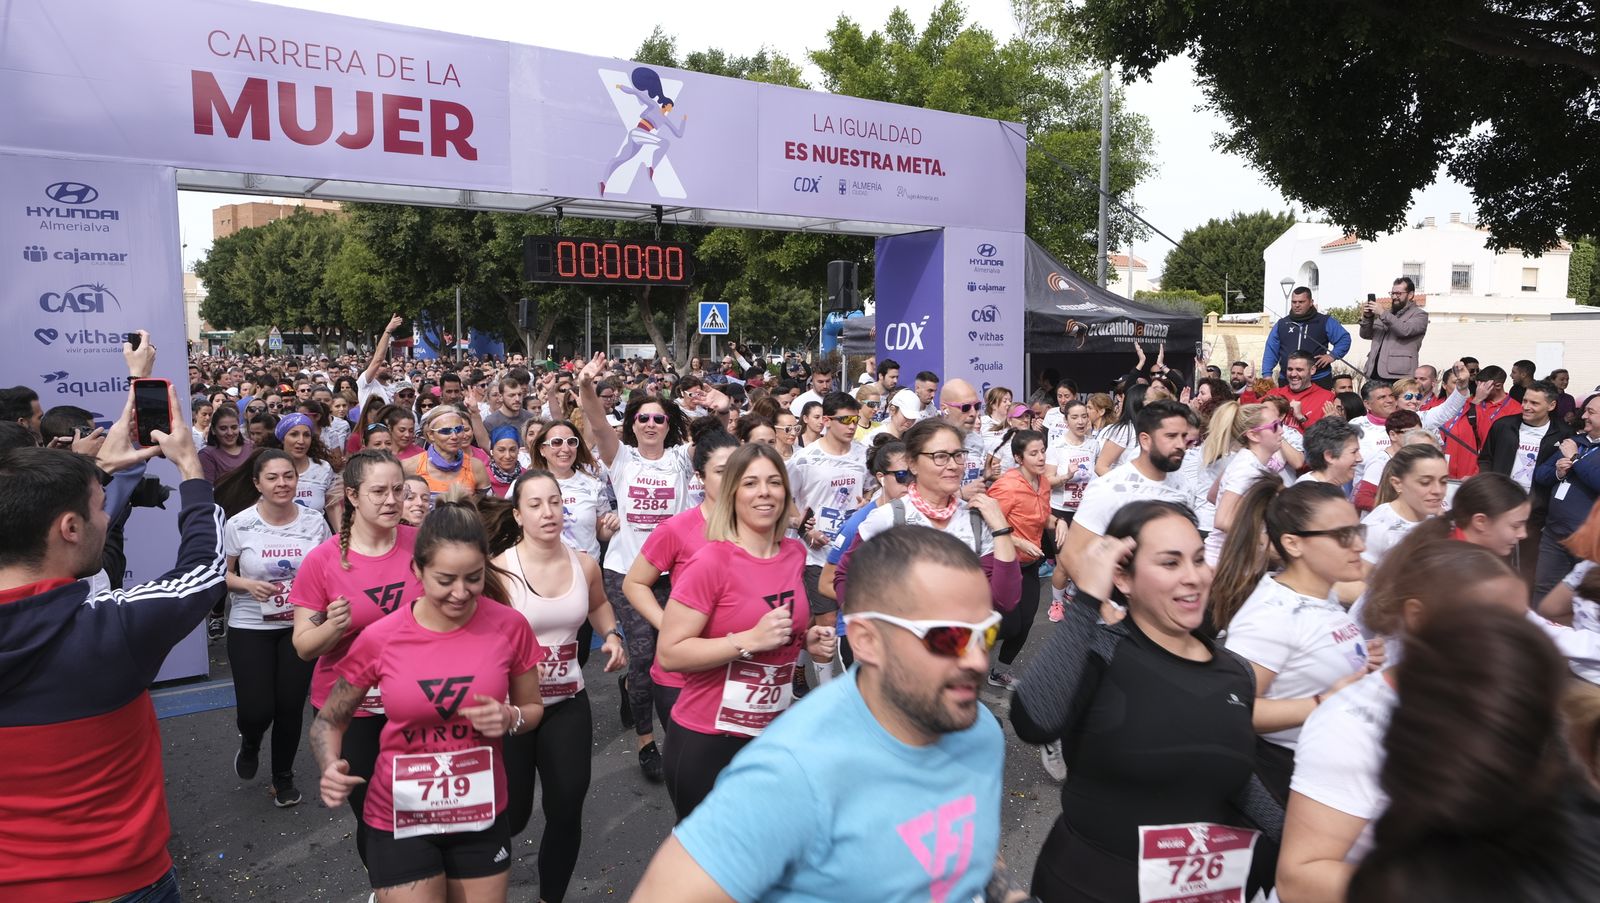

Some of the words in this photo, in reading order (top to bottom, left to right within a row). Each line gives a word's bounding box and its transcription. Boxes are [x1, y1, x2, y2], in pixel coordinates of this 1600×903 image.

[207, 30, 366, 75] CARRERA
[377, 53, 415, 81] DE
[426, 60, 461, 87] LA
[191, 69, 478, 161] MUJER
[813, 114, 834, 133] LA
[840, 117, 922, 145] IGUALDAD
[785, 141, 808, 161] ES
[812, 145, 893, 171] NUESTRA
[897, 155, 946, 176] META.
[852, 181, 882, 191] ALMERÍA
[26, 206, 120, 221] HYUNDAI
[39, 221, 110, 232] Almerialva
[53, 248, 128, 264] cajamar
[969, 258, 1004, 267] HYUNDAI
[978, 283, 1006, 293] cajamar
[39, 292, 104, 313] CASI
[971, 309, 996, 323] CASI
[65, 329, 129, 344] vithas
[979, 332, 1004, 341] vithas
[974, 361, 1003, 373] aqualia
[56, 376, 131, 397] aqualia
[637, 477, 667, 487] MUJER
[831, 478, 856, 487] MUJER
[297, 490, 312, 498] JER
[633, 499, 668, 510] 2584
[262, 549, 302, 558] MUJER
[745, 685, 781, 705] 720
[418, 776, 470, 801] 719
[1168, 853, 1224, 885] 726
